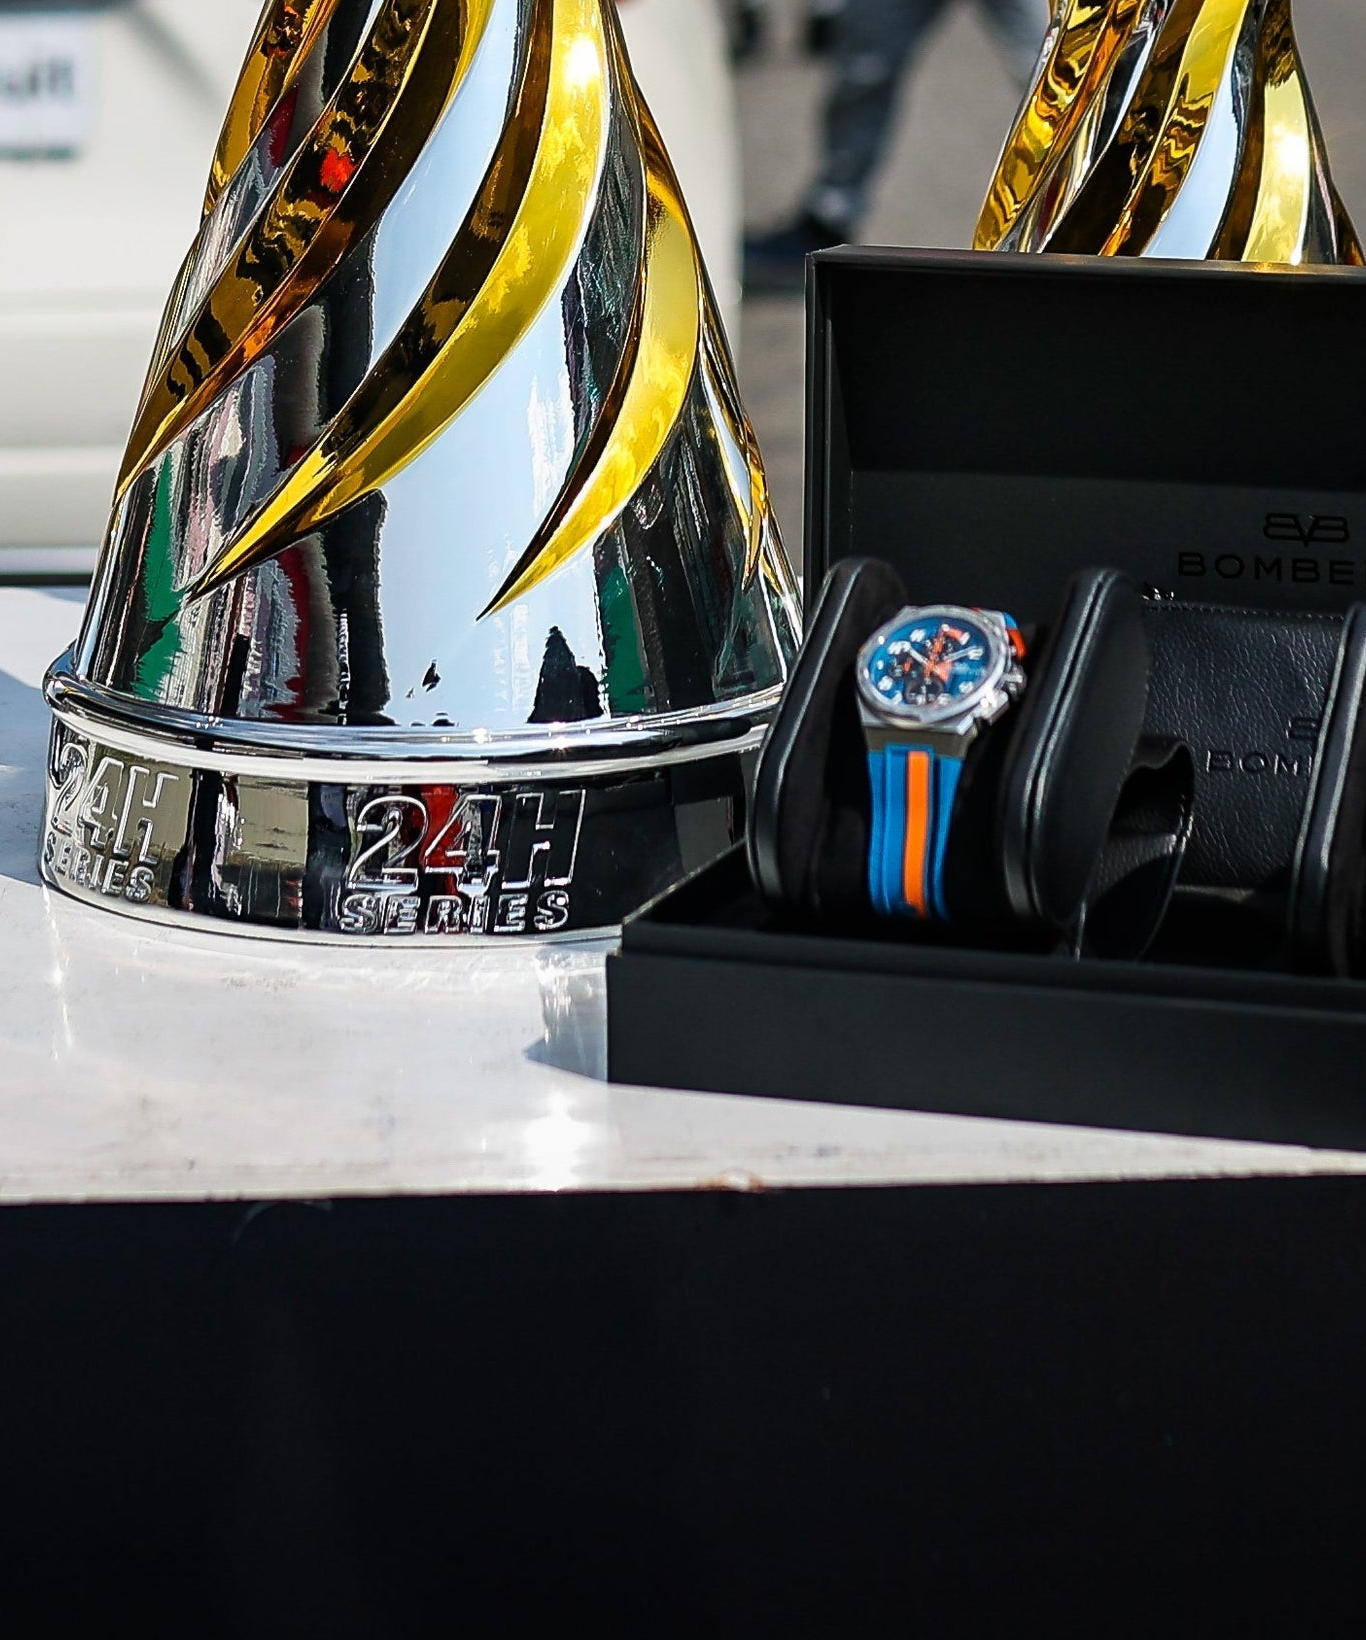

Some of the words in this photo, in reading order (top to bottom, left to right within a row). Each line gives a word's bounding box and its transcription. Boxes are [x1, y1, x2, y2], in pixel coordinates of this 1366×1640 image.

[1206, 749, 1313, 777] BOM
[49, 742, 180, 865] 24H
[347, 788, 586, 892] 24H
[339, 889, 571, 935] SERIES
